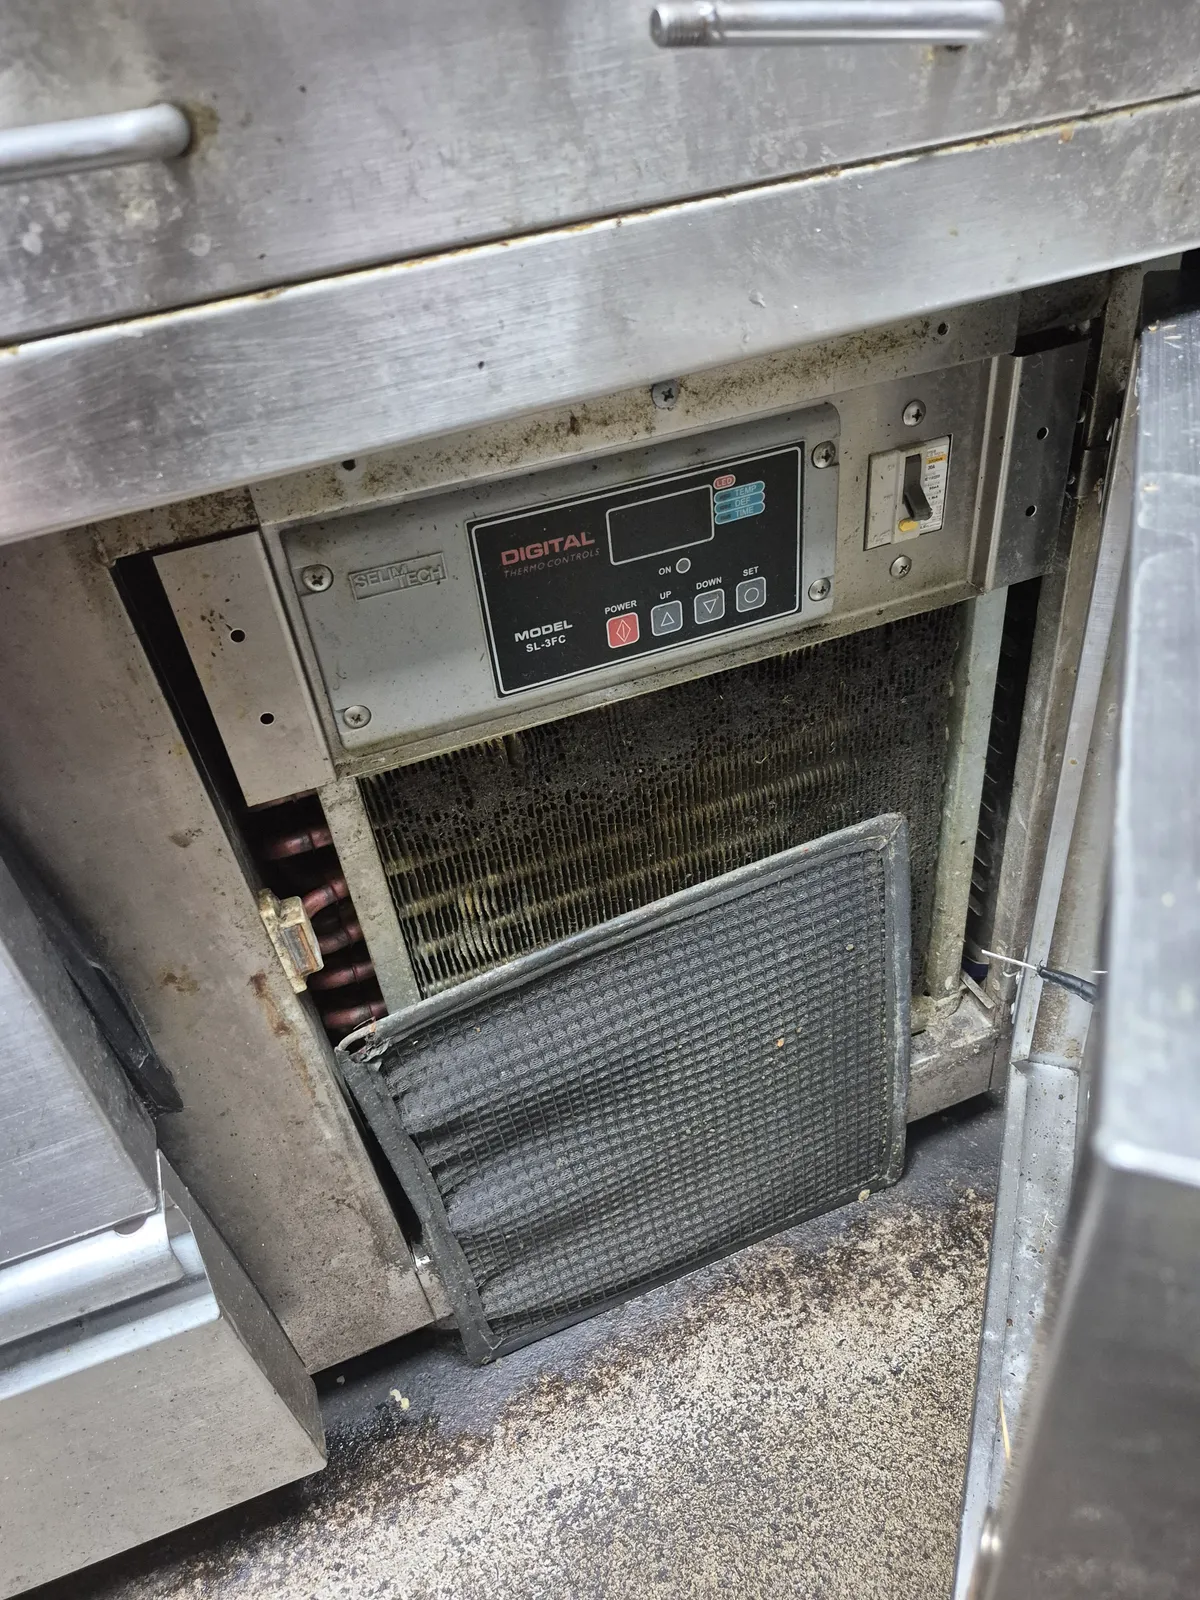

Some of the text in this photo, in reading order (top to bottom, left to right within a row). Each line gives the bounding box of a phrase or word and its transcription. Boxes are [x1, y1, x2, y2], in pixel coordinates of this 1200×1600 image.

[716, 477, 733, 487] LED
[735, 485, 757, 496] TEMP
[734, 497, 751, 508] DEF
[735, 506, 754, 517] TIME
[501, 531, 596, 566] DIGITAL
[504, 548, 601, 578] THERMO CONTROLS
[658, 566, 672, 576] ON
[742, 566, 760, 577] SET
[695, 577, 722, 590] DOWN
[660, 590, 672, 600] UP
[604, 600, 637, 615] POWER
[514, 620, 573, 642] MODEL
[525, 635, 567, 653] SL-3FC
